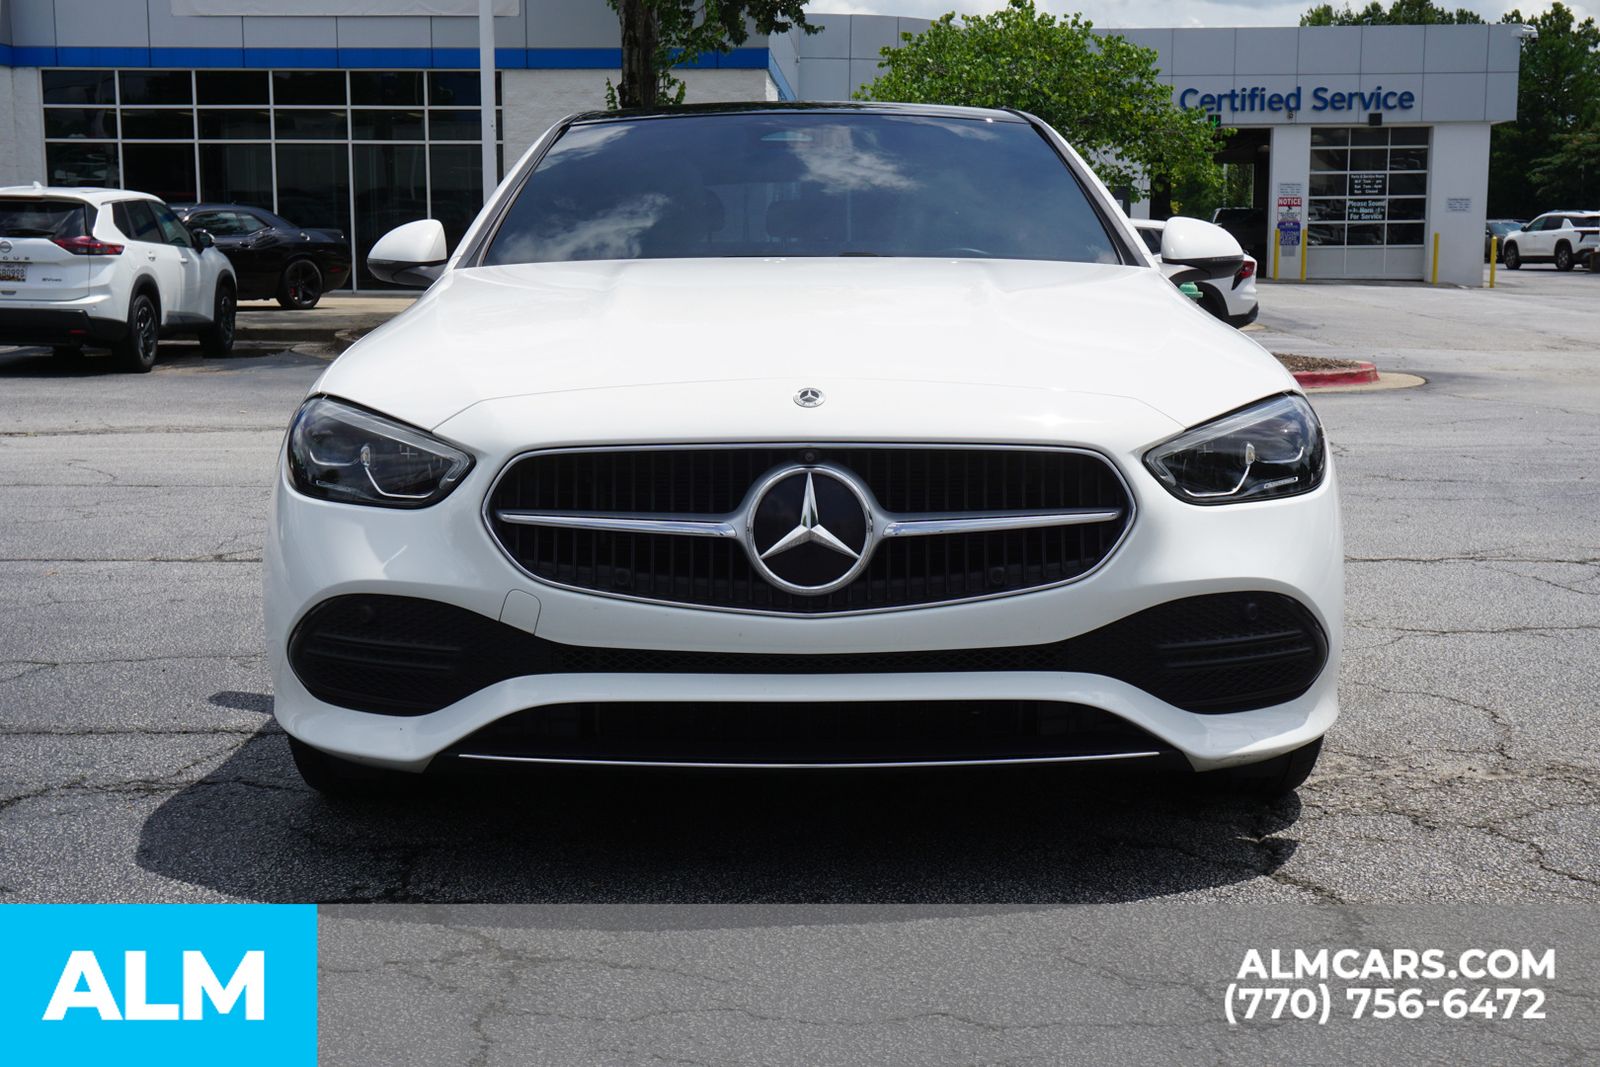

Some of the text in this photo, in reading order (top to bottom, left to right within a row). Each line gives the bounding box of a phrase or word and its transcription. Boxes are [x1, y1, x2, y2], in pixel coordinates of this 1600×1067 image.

[1179, 86, 1415, 112] Certified Service
[1278, 198, 1301, 206] NOTICE
